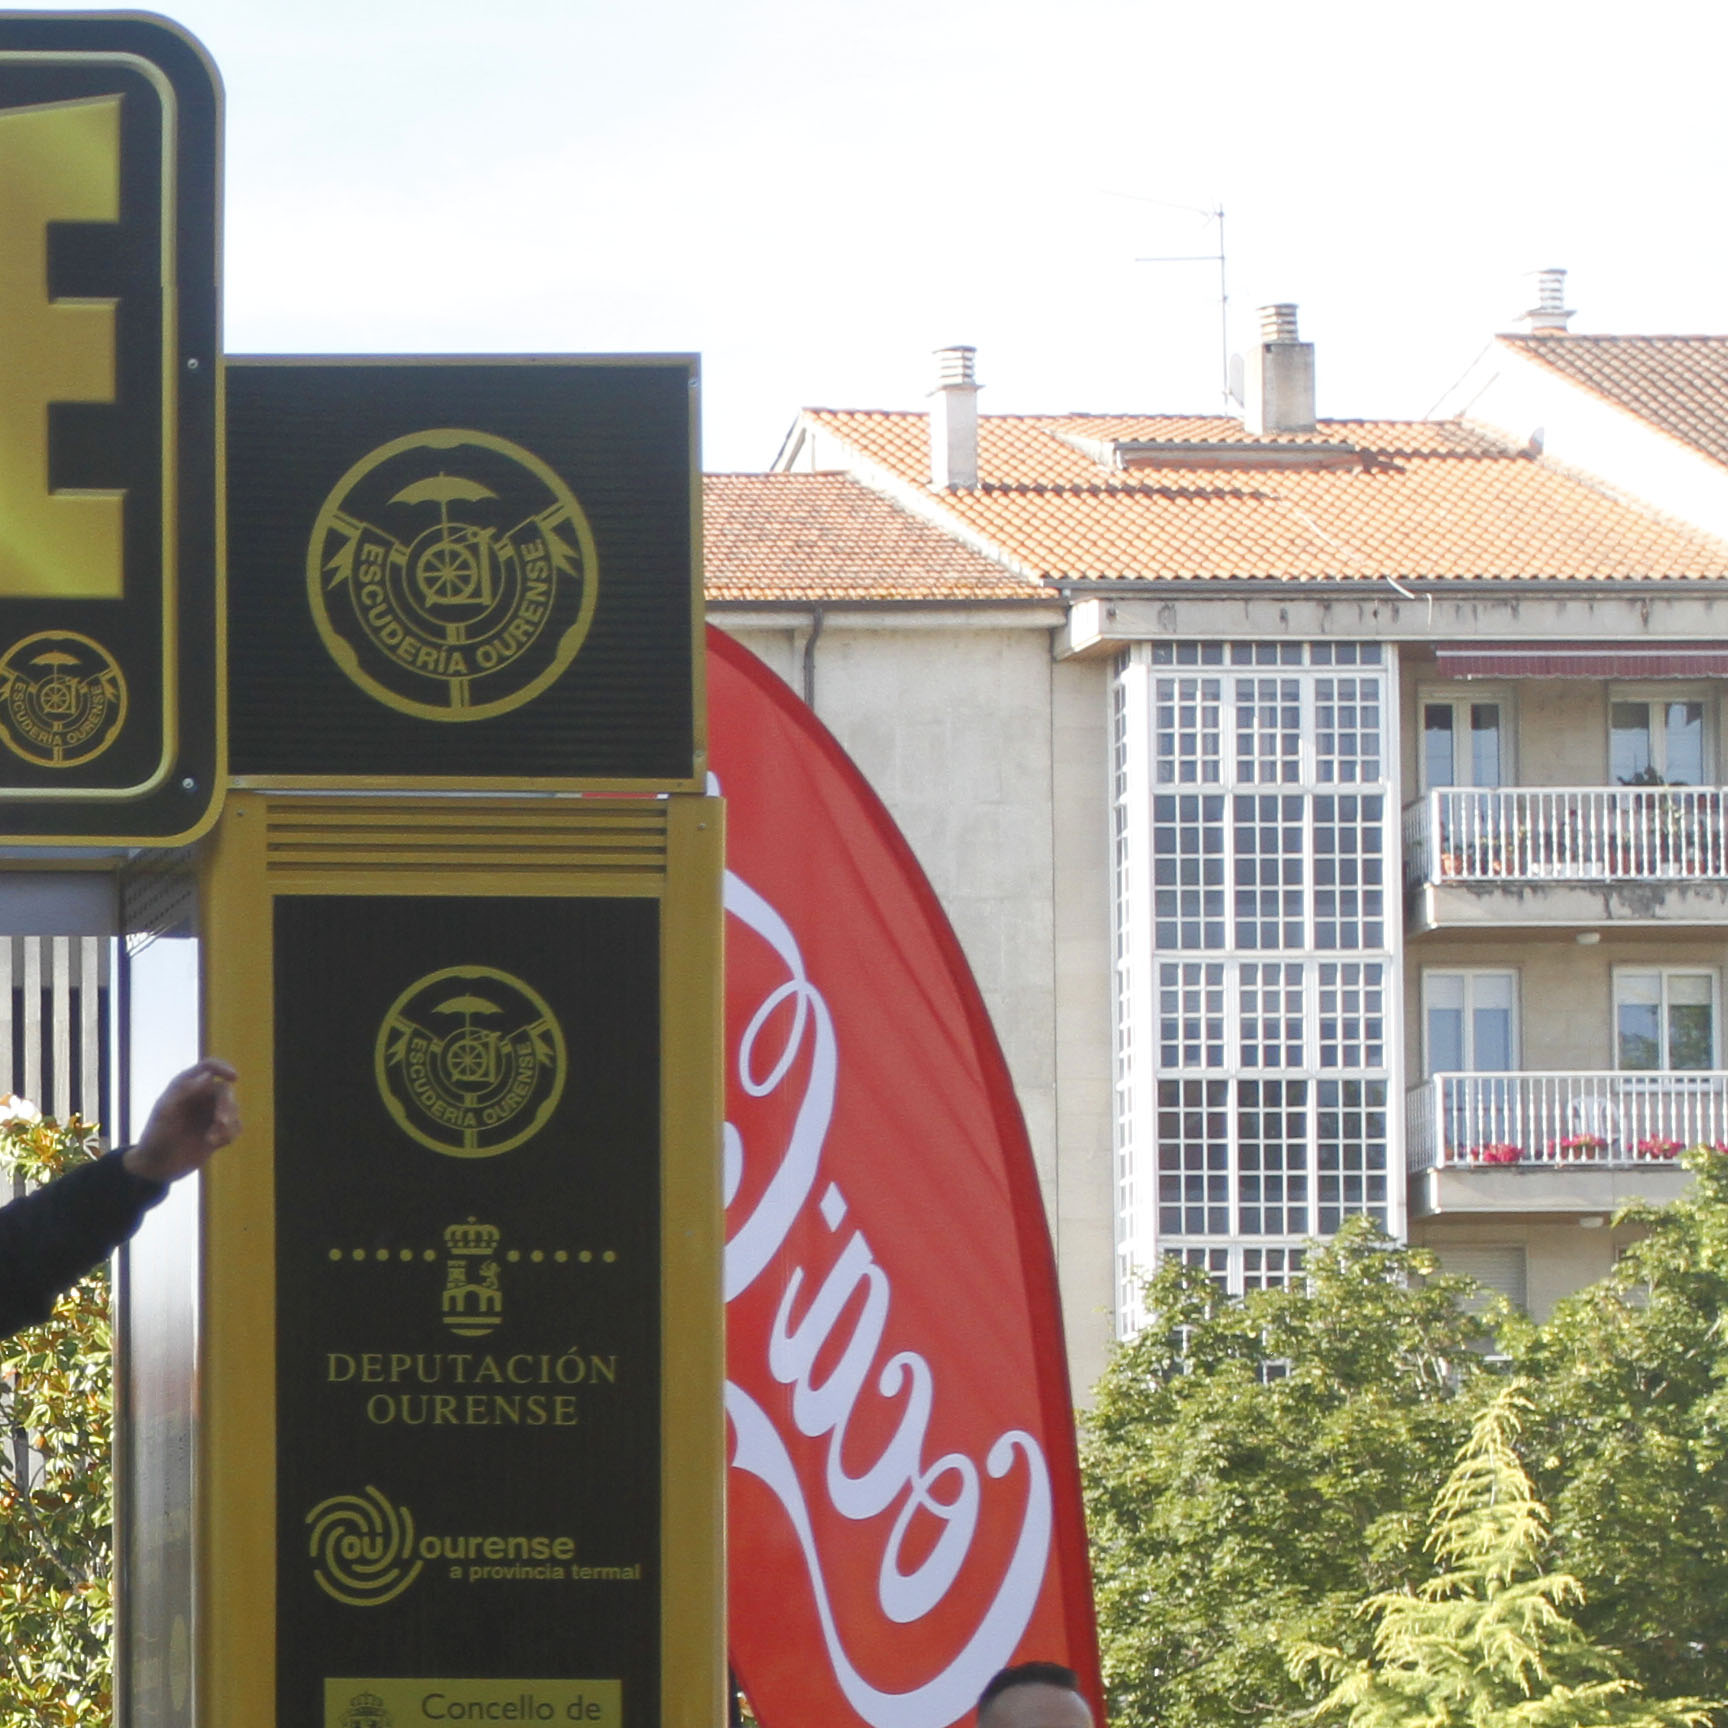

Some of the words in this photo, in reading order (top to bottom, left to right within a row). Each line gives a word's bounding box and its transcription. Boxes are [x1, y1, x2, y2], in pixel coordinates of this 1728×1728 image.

[359, 543, 467, 676] ESCUDERÍA
[476, 539, 549, 671] OURENSE
[410, 1038, 477, 1129] ESCUDERÍA
[481, 1040, 533, 1125] OURENSE
[326, 1346, 618, 1385] DEPUTACIÓN
[366, 1393, 580, 1427] OURENSE
[419, 1534, 575, 1562] ourense
[448, 1566, 463, 1581] a
[468, 1562, 565, 1584] provincia
[570, 1562, 641, 1581] termal
[420, 1693, 556, 1722] Concello
[566, 1695, 602, 1722] de
